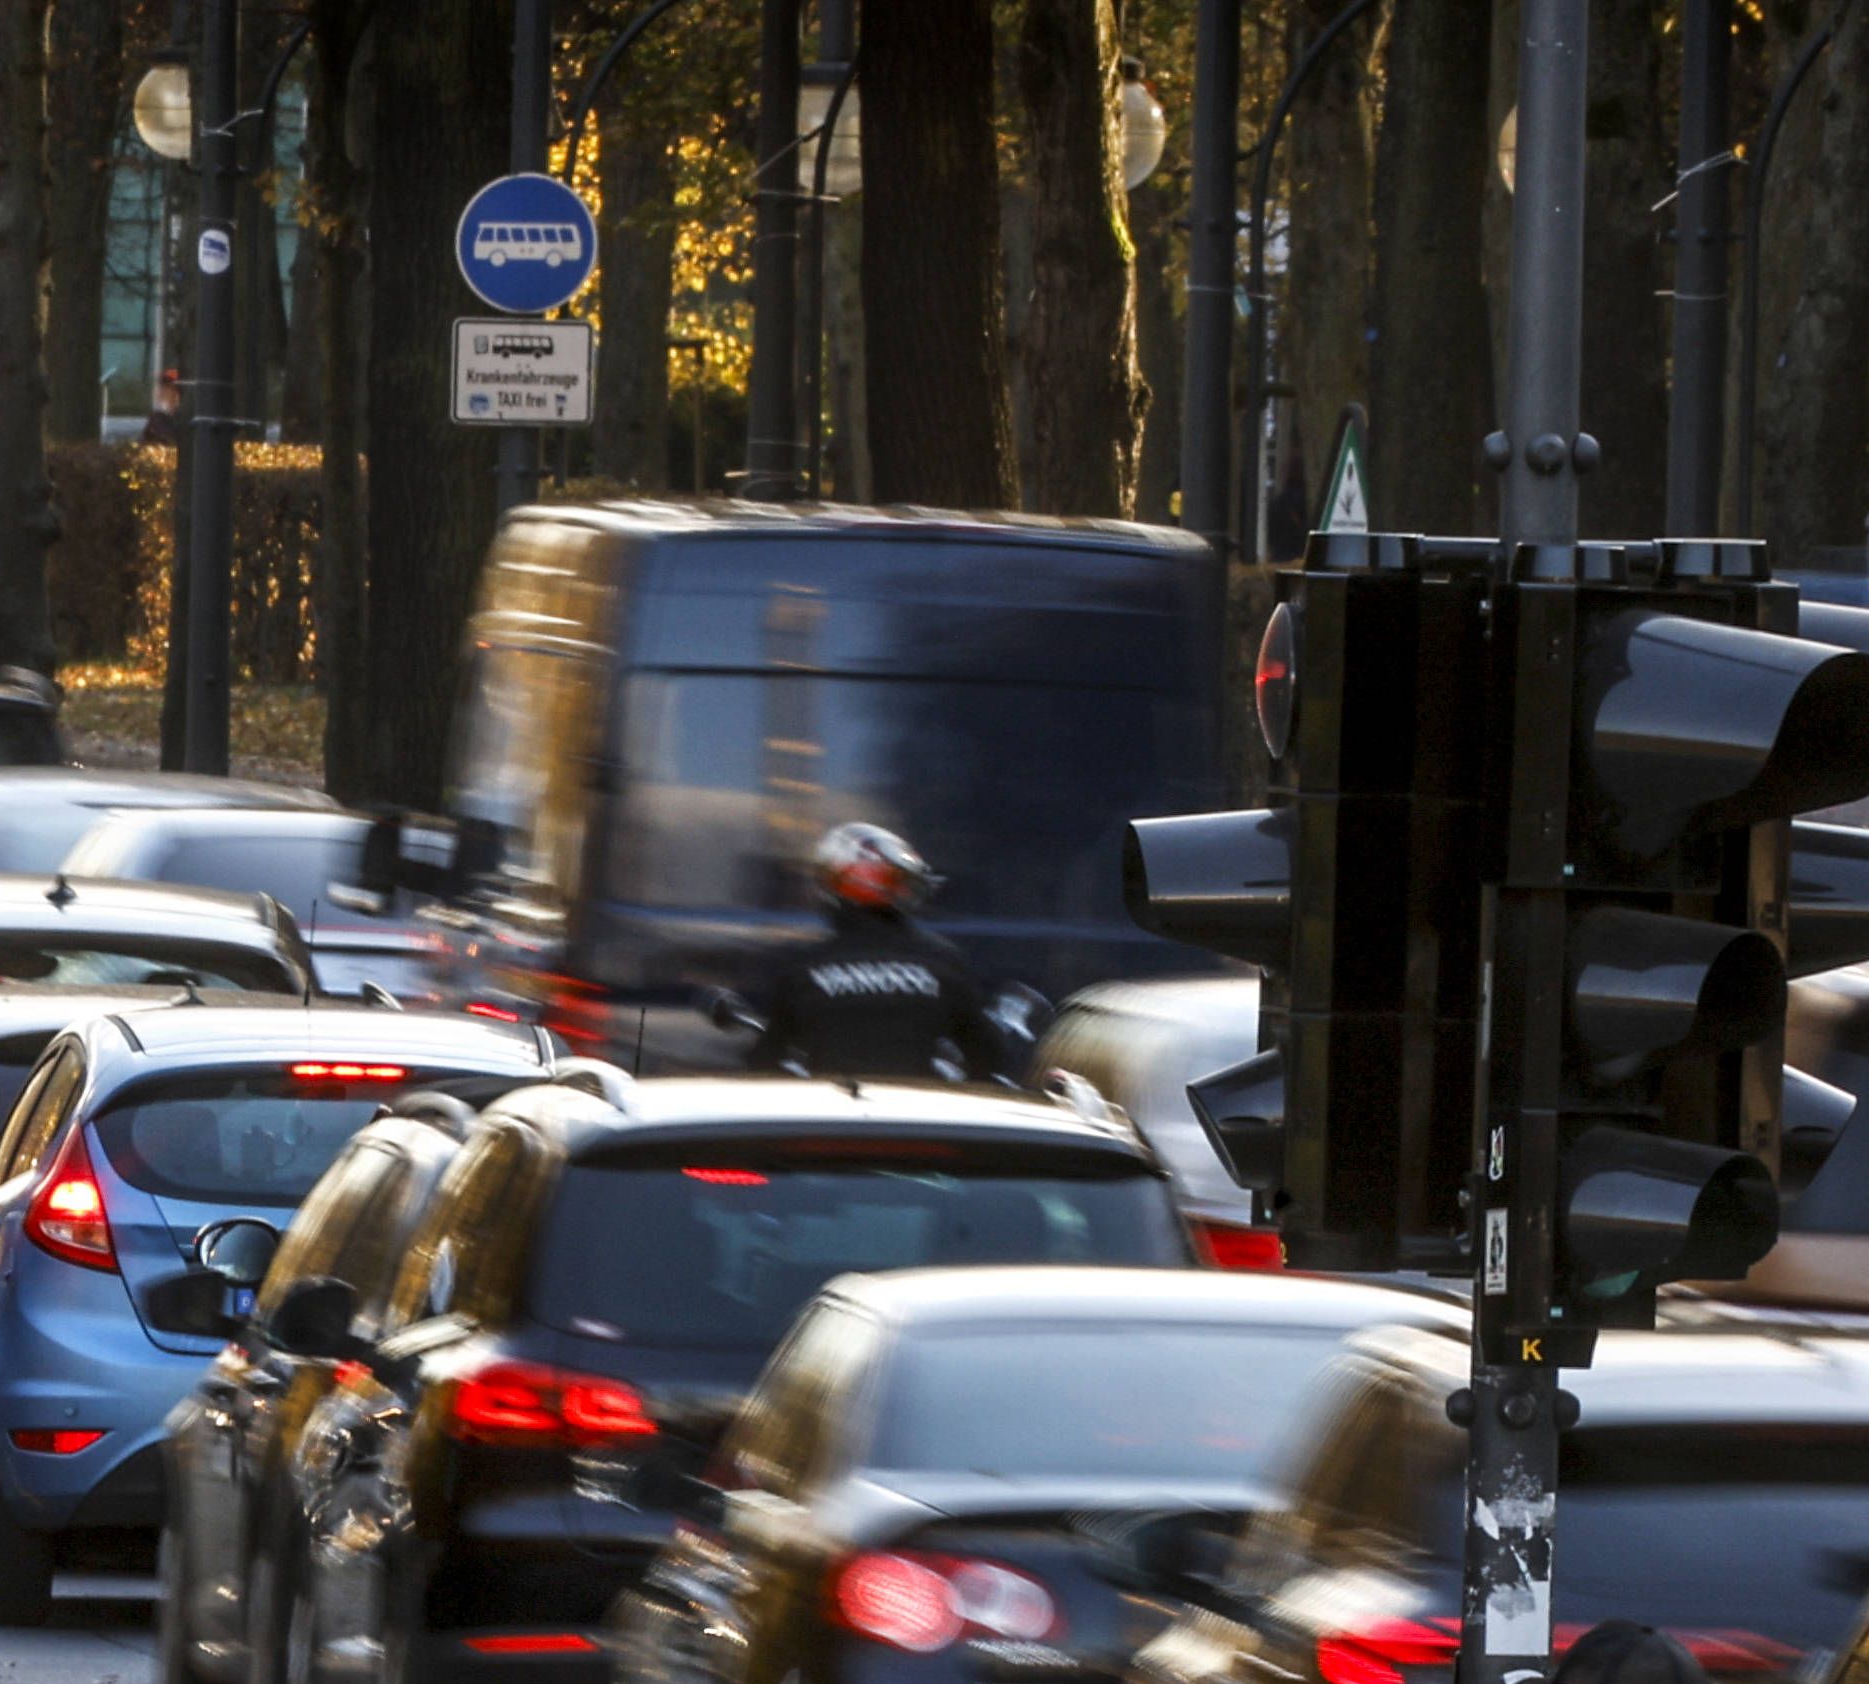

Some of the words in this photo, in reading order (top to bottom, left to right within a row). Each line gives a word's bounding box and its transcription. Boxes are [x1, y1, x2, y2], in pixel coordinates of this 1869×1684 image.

[467, 368, 578, 389] Krankenfahrzeuge
[498, 391, 522, 407] TAXI
[526, 391, 548, 407] frei
[1522, 1338, 1543, 1361] K
